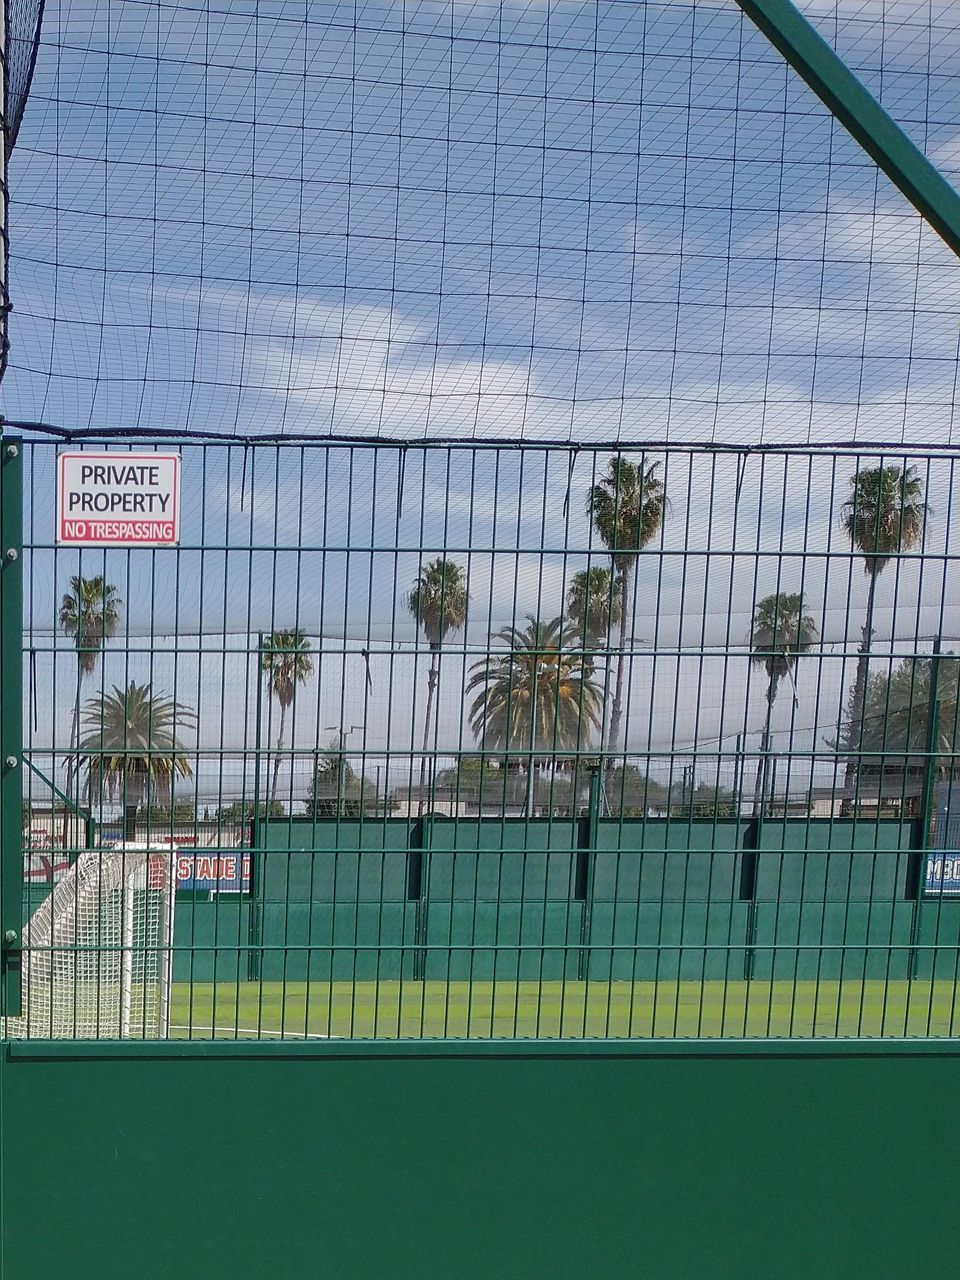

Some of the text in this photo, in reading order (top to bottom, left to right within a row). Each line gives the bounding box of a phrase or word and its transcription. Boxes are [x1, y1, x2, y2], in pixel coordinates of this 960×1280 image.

[81, 465, 159, 486] PRIVATE
[69, 492, 170, 513] PROPERTY
[64, 522, 173, 539] NO TRESPASSING
